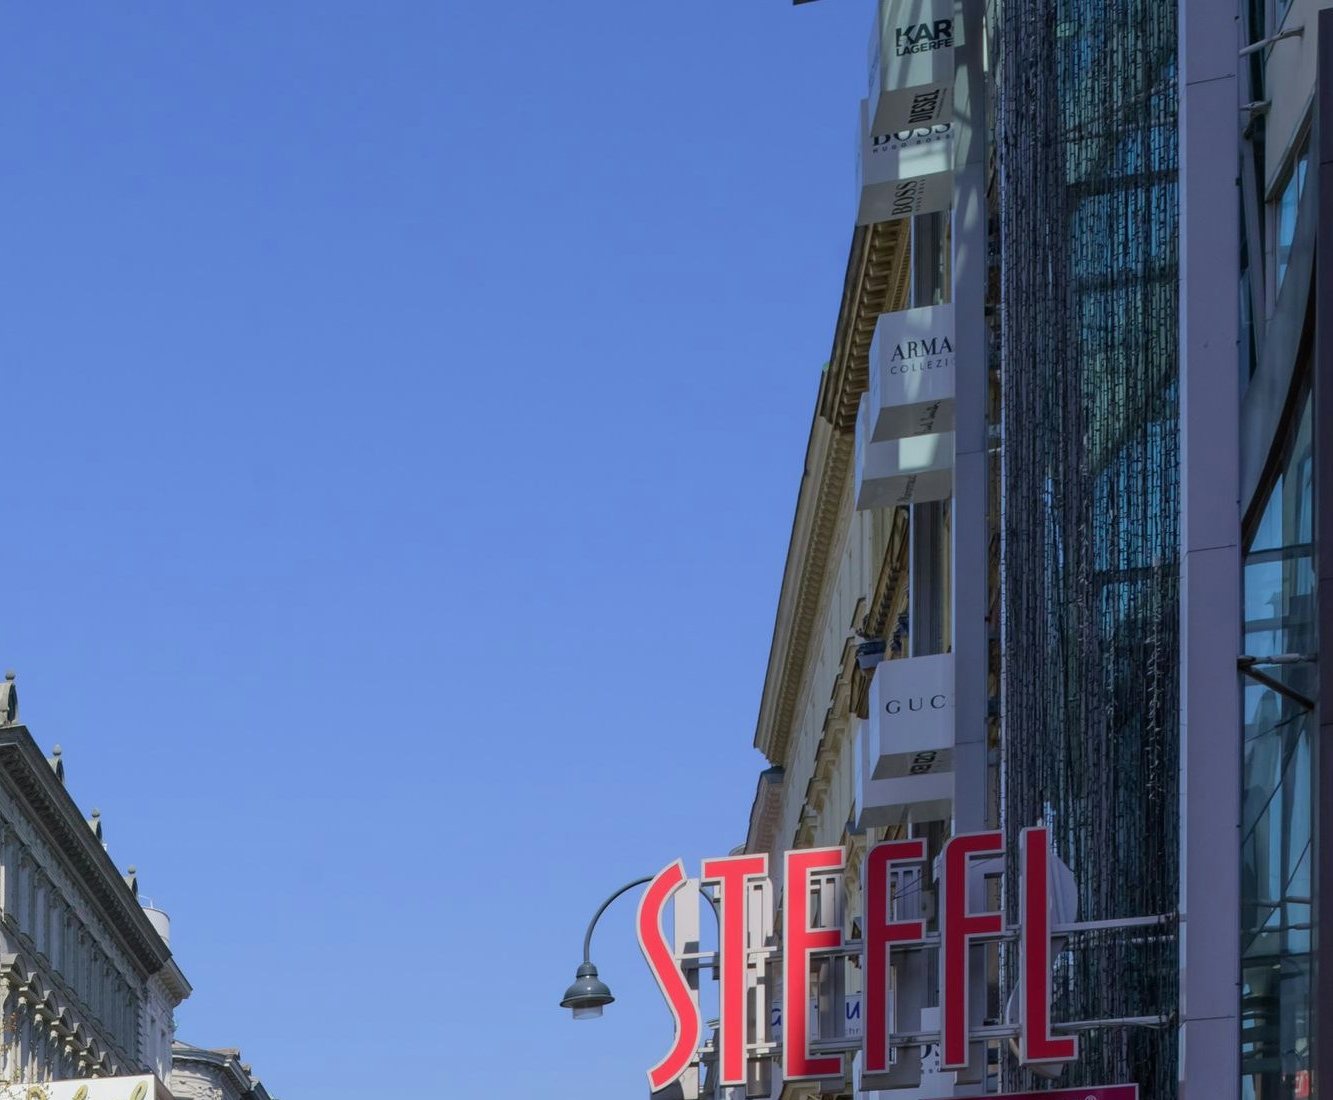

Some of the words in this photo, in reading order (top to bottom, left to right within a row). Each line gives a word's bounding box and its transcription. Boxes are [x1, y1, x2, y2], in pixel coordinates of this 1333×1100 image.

[908, 89, 940, 124] DIESEL
[892, 180, 918, 216] BOSS
[636, 826, 1080, 1093] STEFFL
